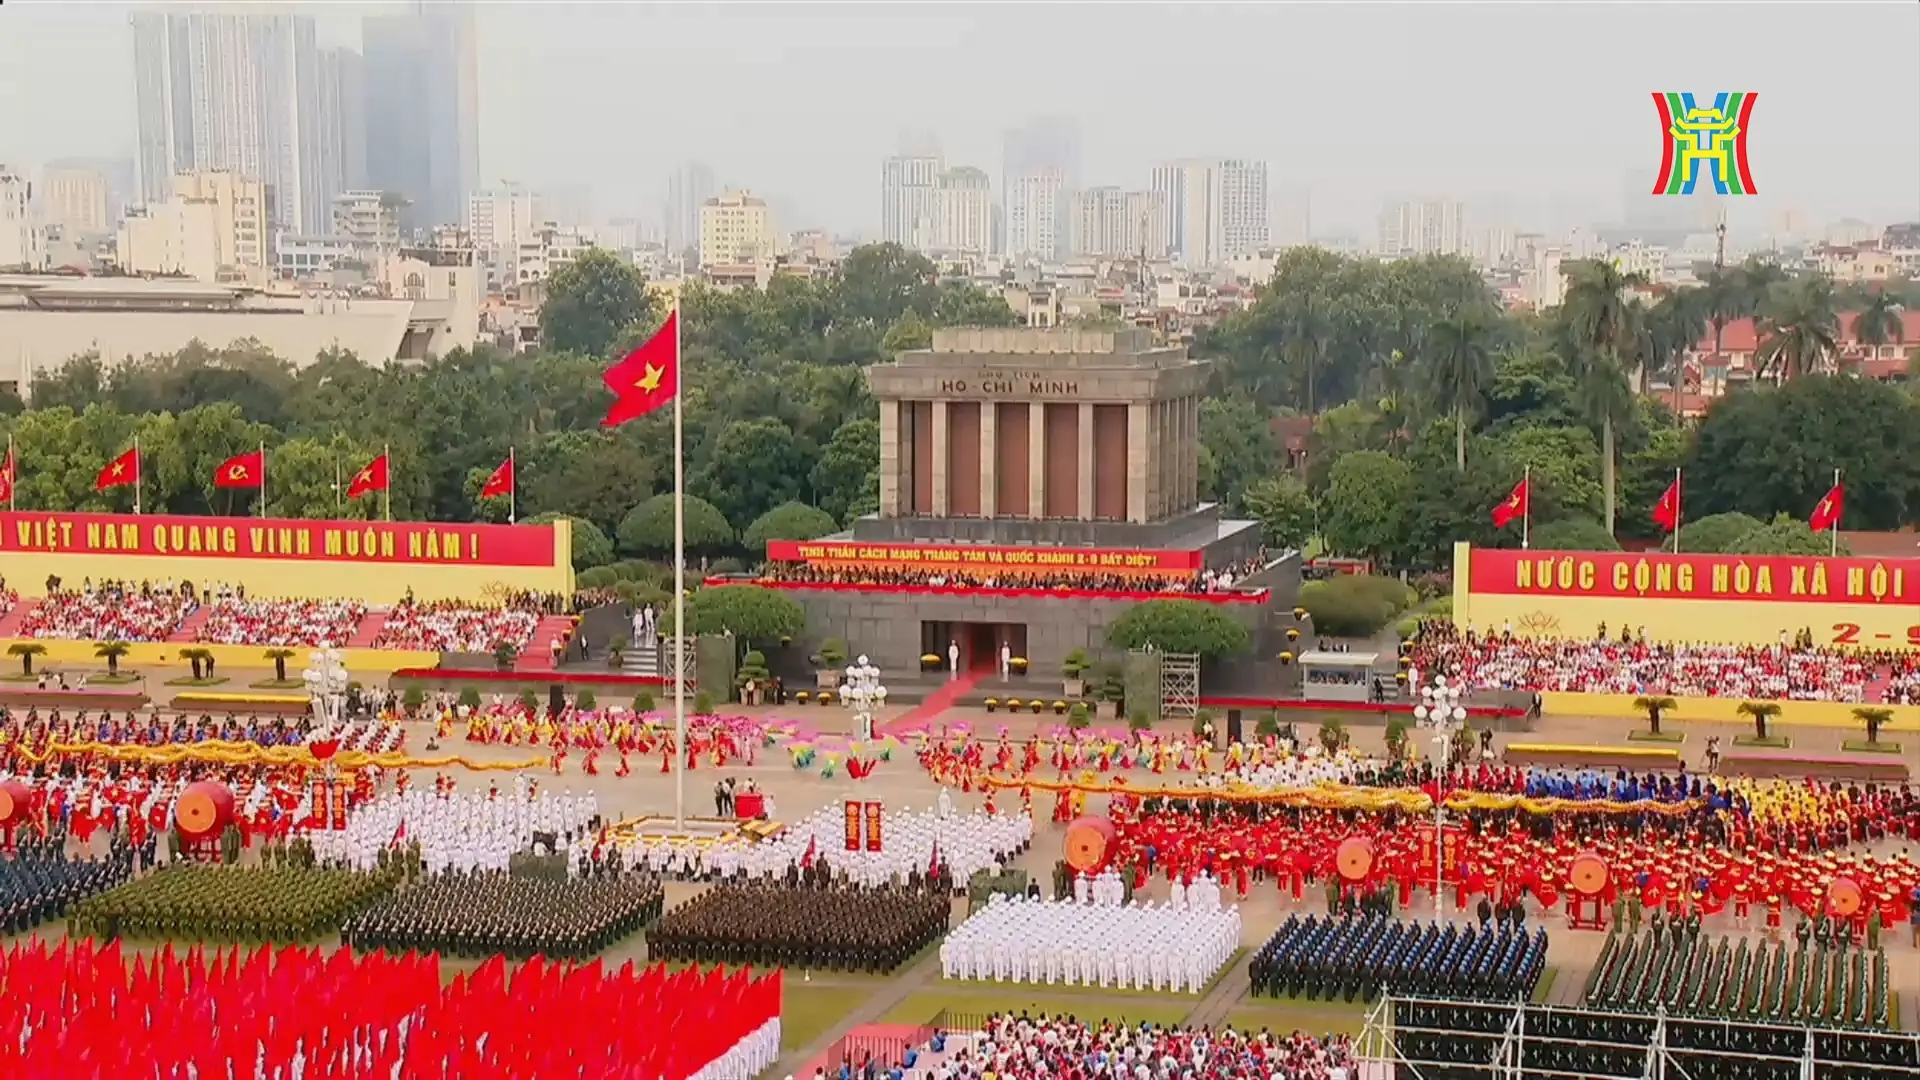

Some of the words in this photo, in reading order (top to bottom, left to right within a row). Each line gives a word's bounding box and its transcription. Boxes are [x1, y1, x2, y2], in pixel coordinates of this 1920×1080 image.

[17, 516, 73, 552] VIỆT
[87, 522, 140, 549] NAM
[153, 524, 237, 553] QUANG
[250, 527, 310, 554] VINH
[325, 526, 394, 557] MUÔN
[1516, 556, 1596, 590] NƯỚC
[1613, 557, 1694, 596] CỘNG
[1712, 560, 1772, 594] HÒA
[1790, 560, 1828, 595] XÃ
[1847, 561, 1903, 602] HỘI
